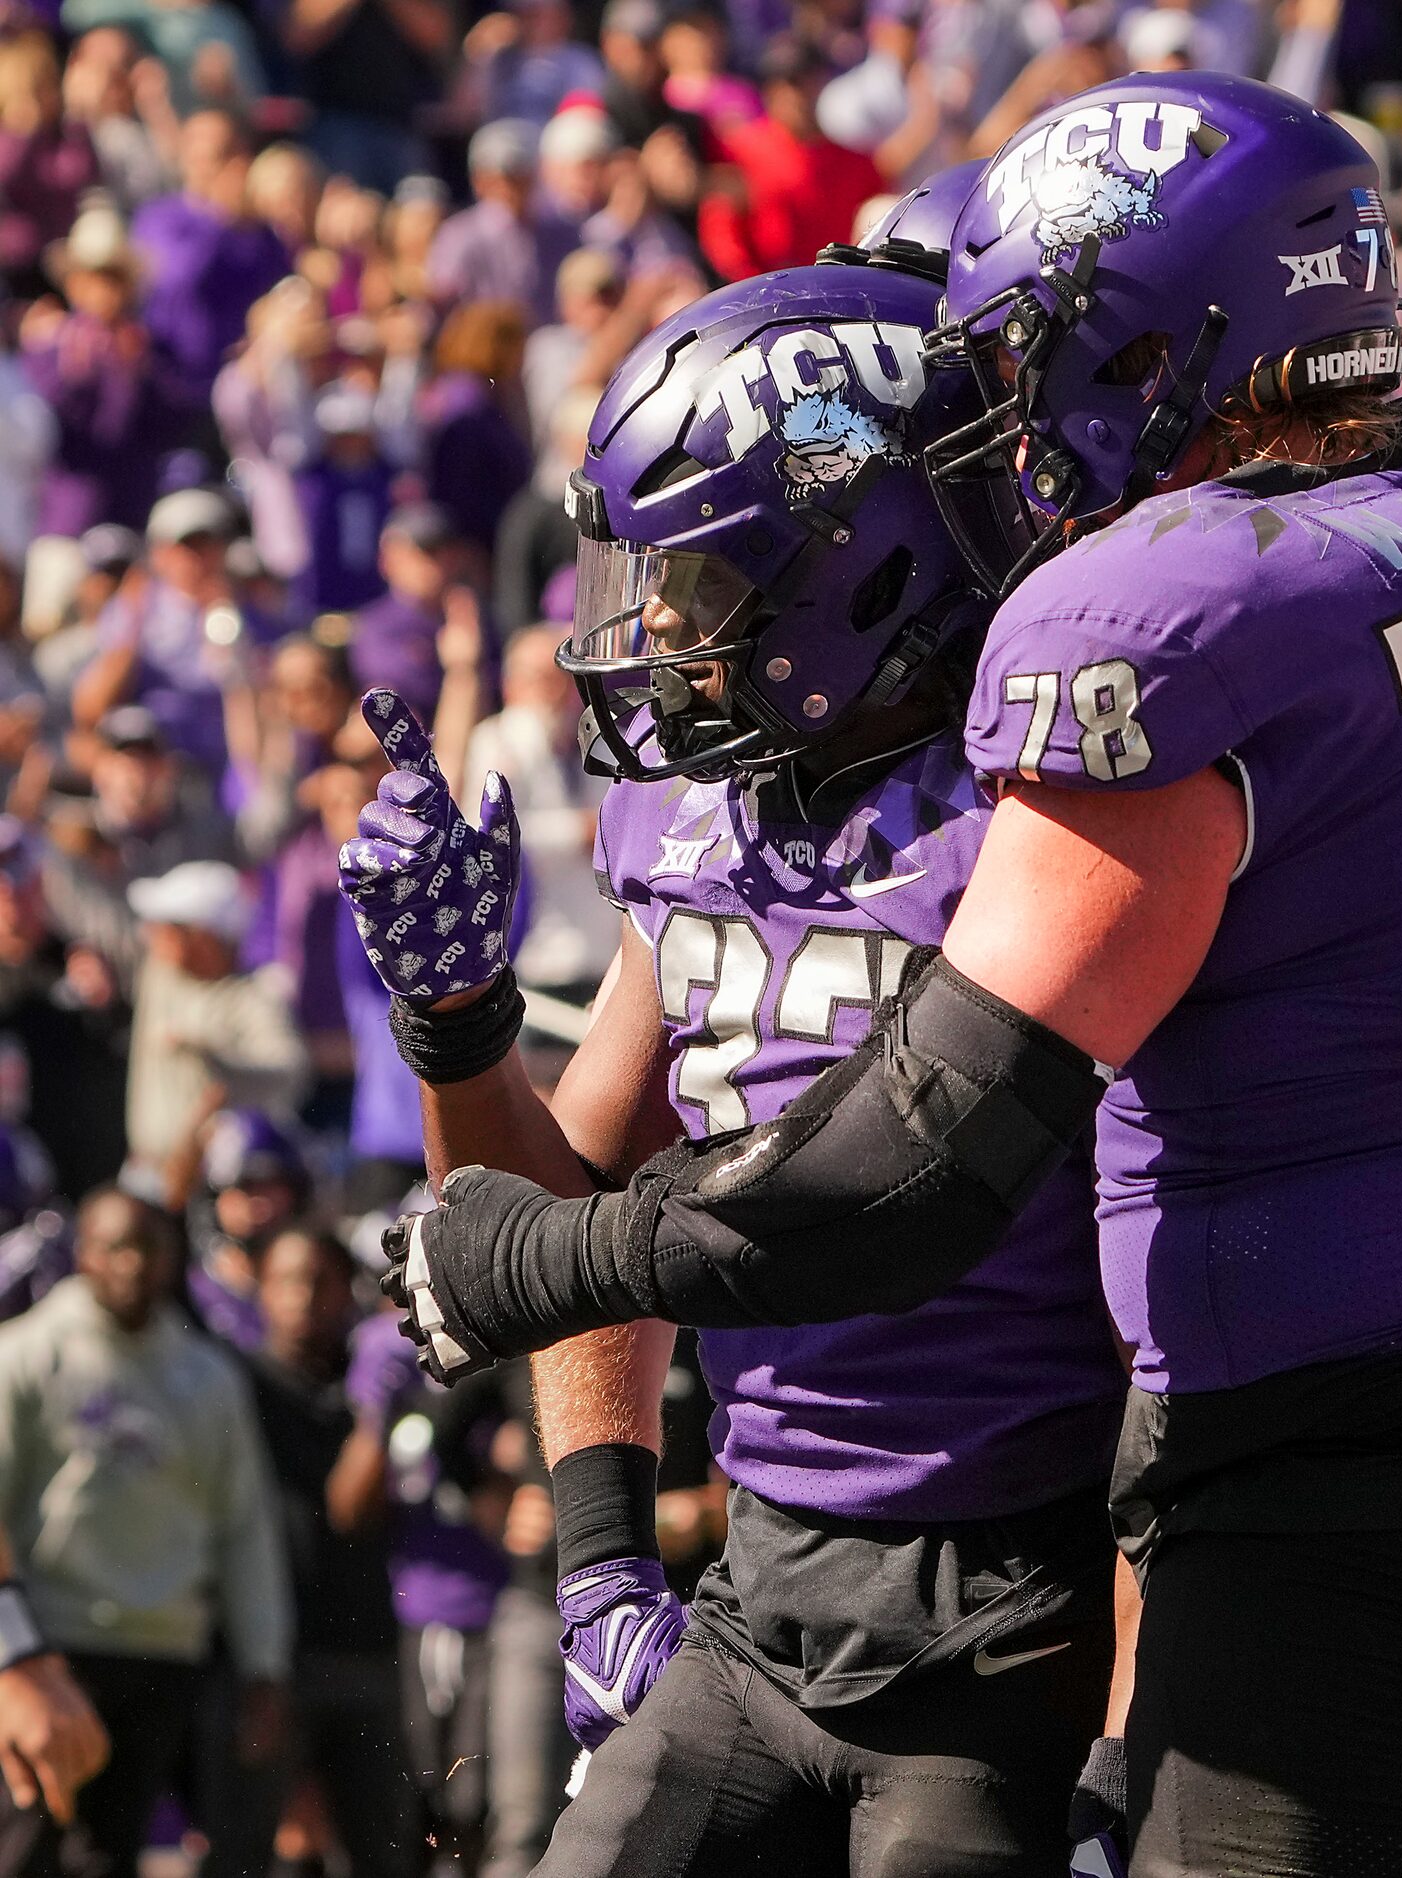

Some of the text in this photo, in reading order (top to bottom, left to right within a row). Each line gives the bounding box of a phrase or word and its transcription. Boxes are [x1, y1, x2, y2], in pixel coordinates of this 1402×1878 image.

[986, 101, 1202, 236] TCU
[1277, 244, 1349, 296] XII
[1306, 347, 1398, 385] HORNED
[694, 322, 928, 463] TCU
[383, 719, 410, 752] TCU
[1004, 657, 1157, 782] 78
[647, 833, 721, 880] XII
[784, 839, 815, 870] TCU
[426, 863, 452, 901] TCU
[471, 889, 499, 926] TCU
[385, 911, 417, 945] TCU
[434, 940, 466, 975] TCU
